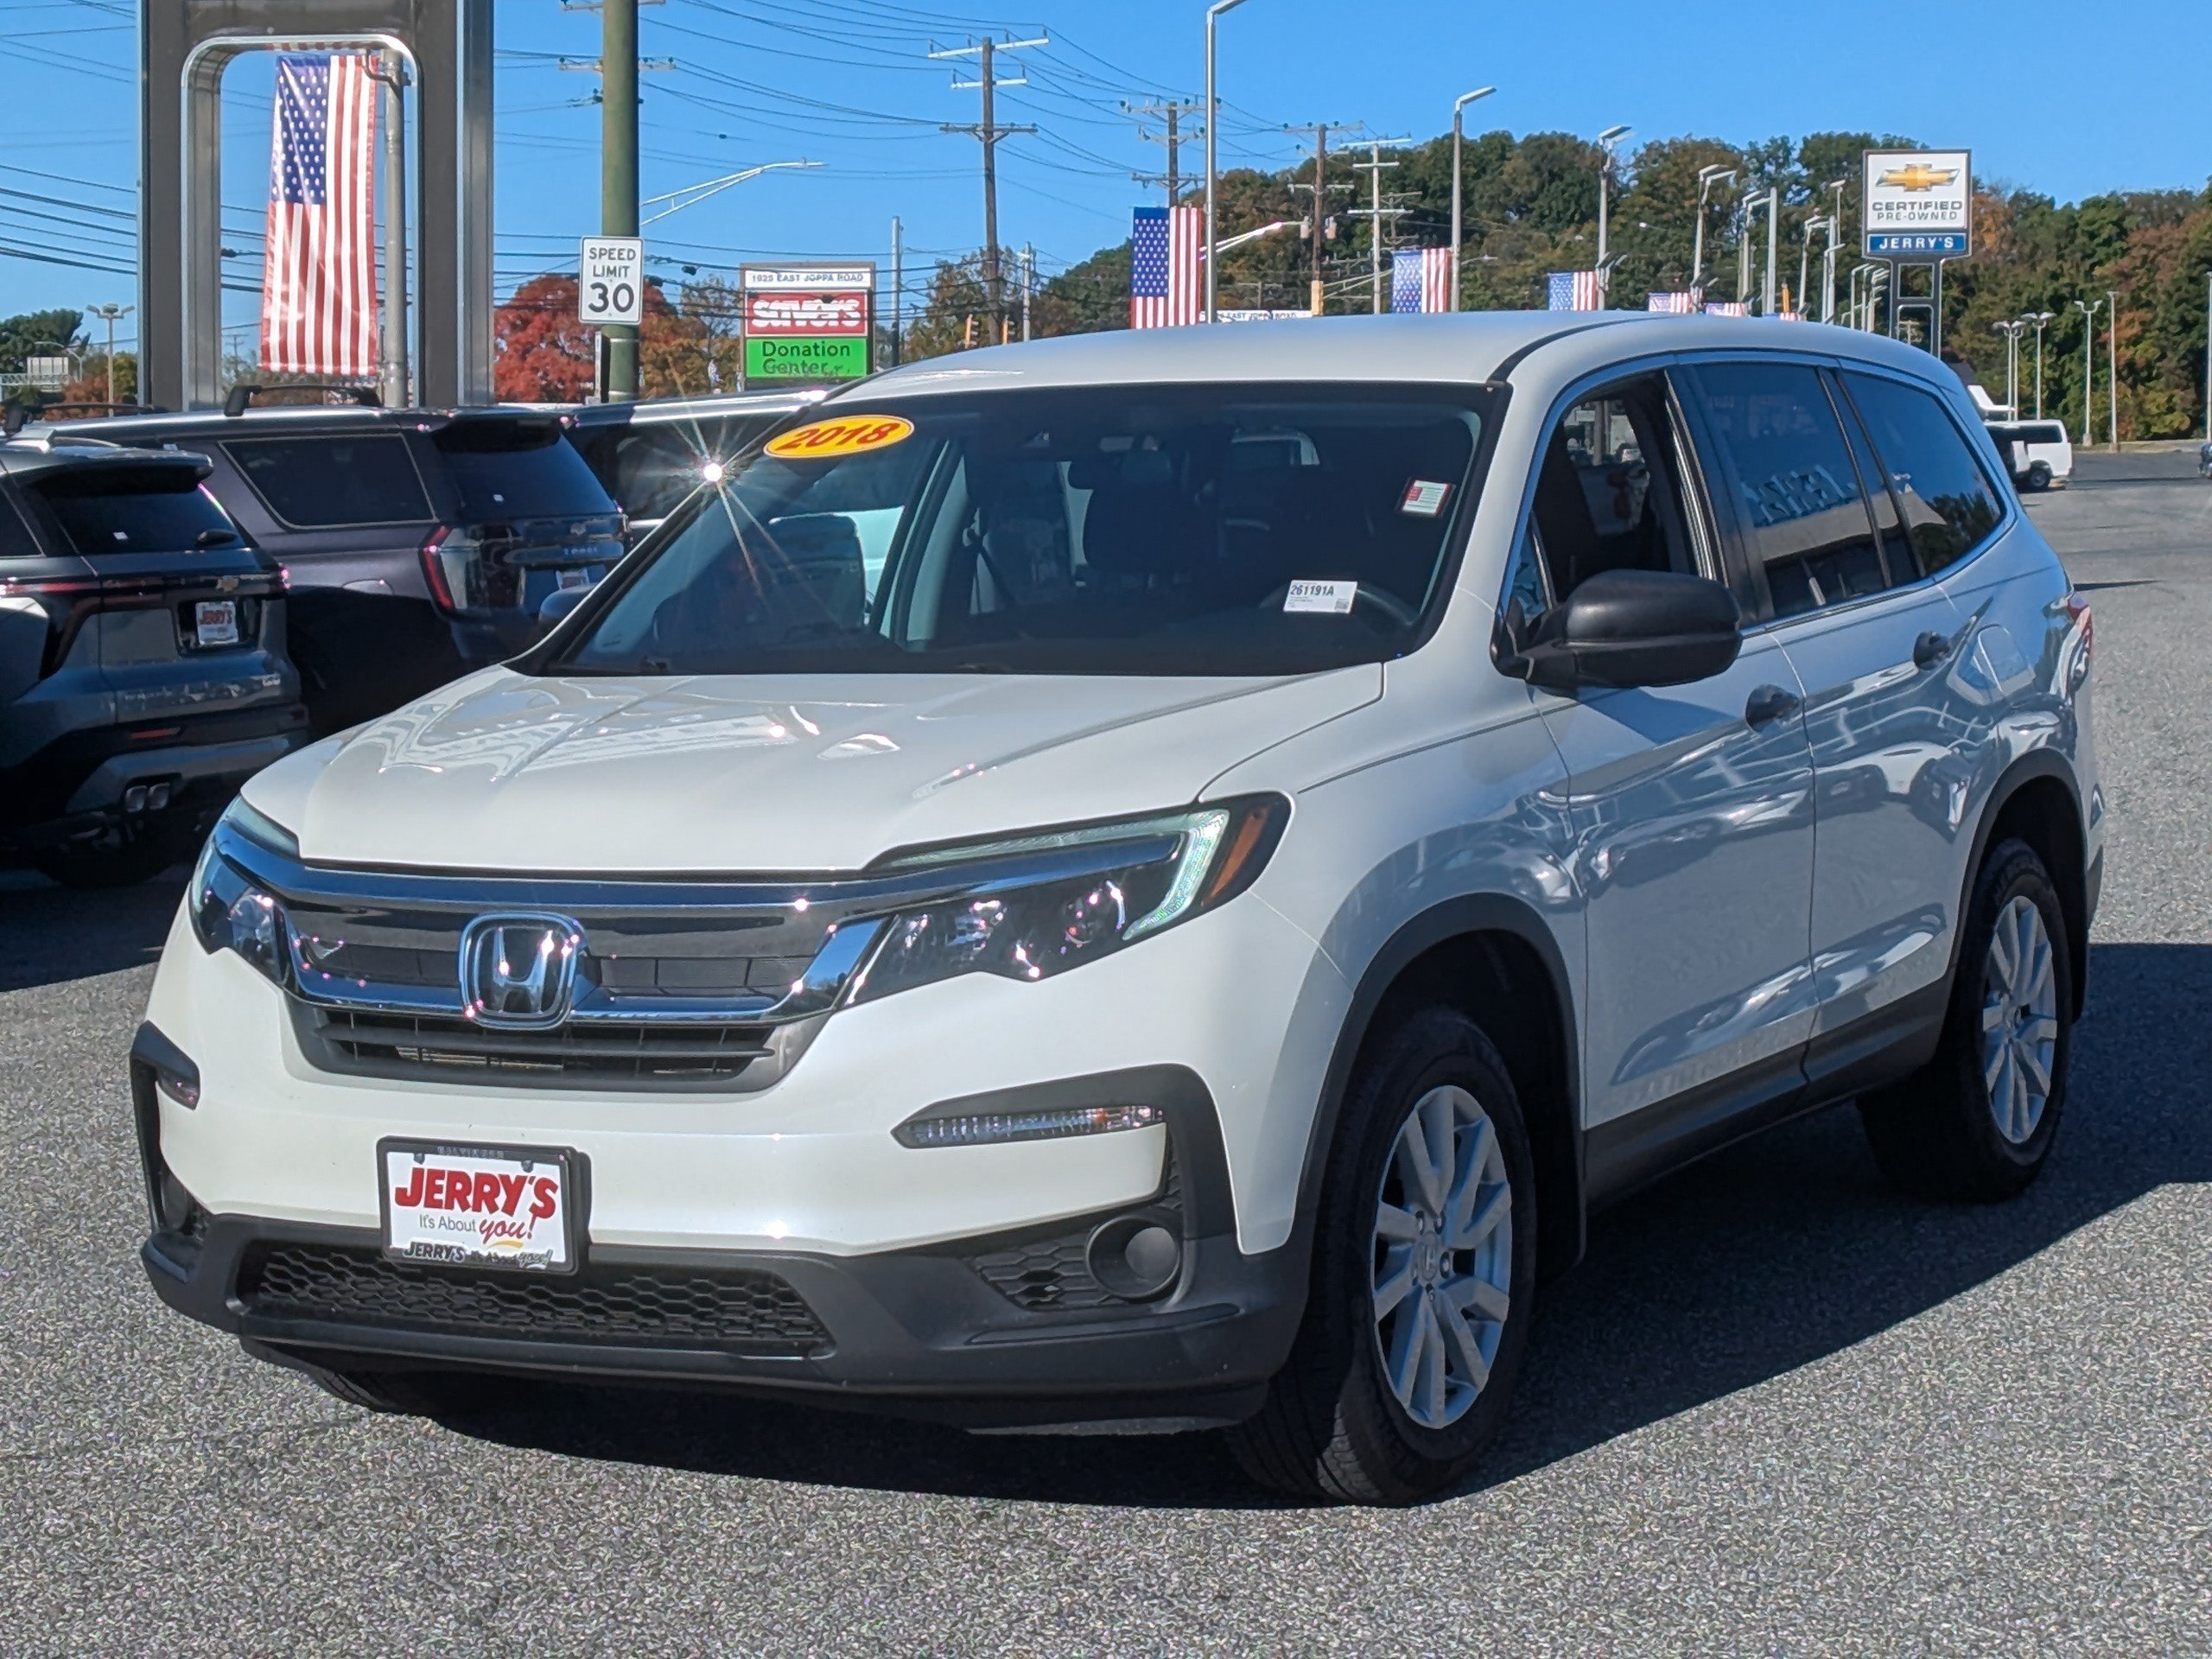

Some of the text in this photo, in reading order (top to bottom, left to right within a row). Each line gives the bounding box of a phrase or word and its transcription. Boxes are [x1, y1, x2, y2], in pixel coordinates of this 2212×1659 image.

[1872, 200, 1963, 212] CERTIFIED
[1877, 211, 1958, 220] PRE-OWNED
[1878, 236, 1955, 250] JERRY'S
[588, 246, 637, 261] SPEED
[593, 264, 630, 277] LIMIT
[777, 273, 801, 283] EAST
[804, 273, 835, 283] JOPPA
[836, 272, 863, 282] ROAD
[588, 282, 635, 313] 30
[761, 340, 851, 357] Donation
[762, 358, 829, 375] Center
[774, 423, 901, 451] 2018
[1290, 584, 1335, 596] 261191A
[394, 1166, 559, 1219] JERRY'S
[419, 1213, 537, 1244] It's About you!
[403, 1241, 467, 1263] JERRY'S
